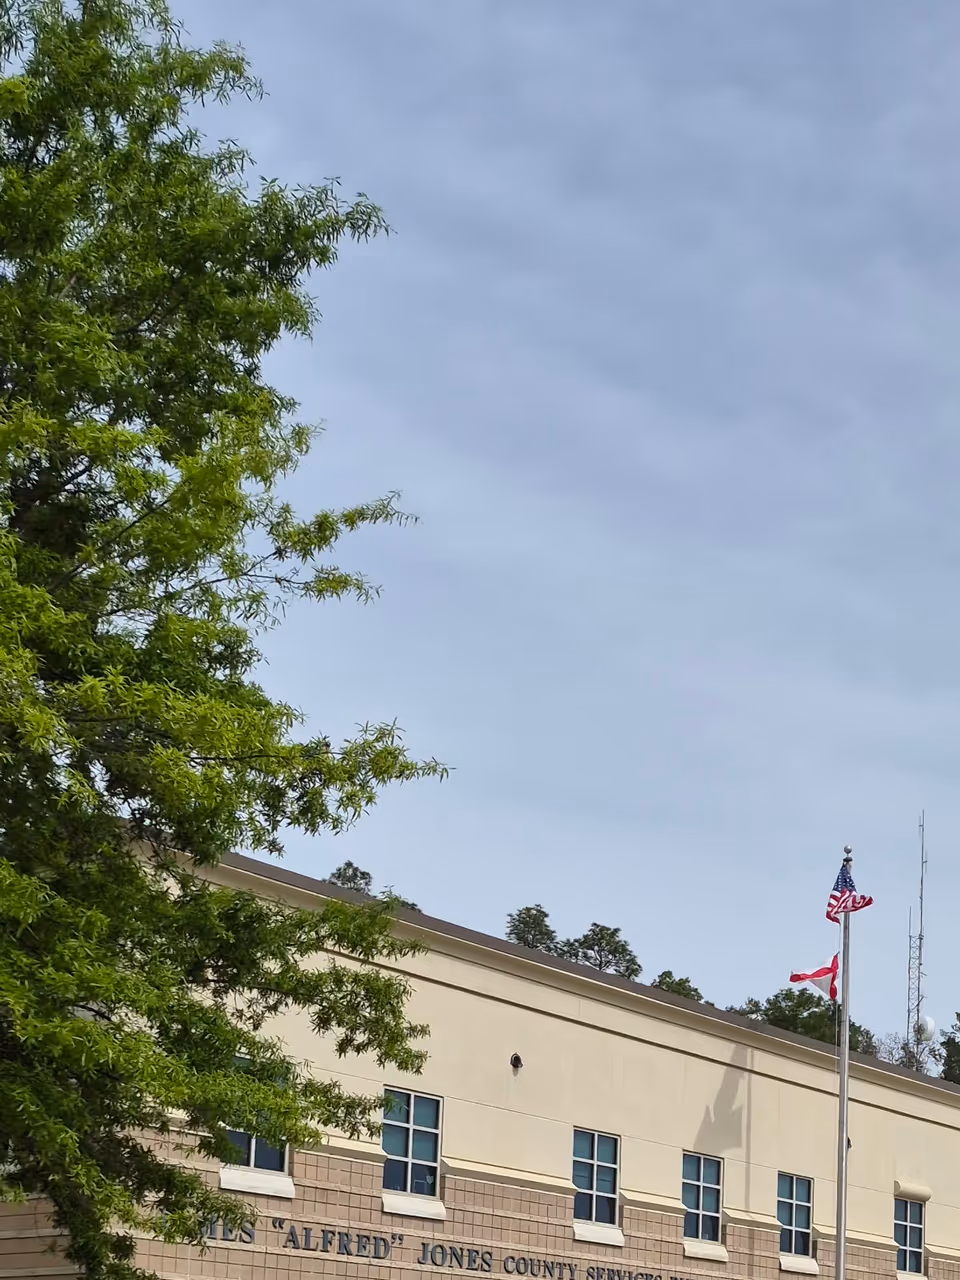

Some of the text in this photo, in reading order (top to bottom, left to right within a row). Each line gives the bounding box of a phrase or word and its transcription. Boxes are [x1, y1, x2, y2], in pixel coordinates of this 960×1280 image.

[272, 1219, 404, 1259] “ALFRED”
[418, 1242, 493, 1272] JONES
[504, 1256, 578, 1280] COUNTY
